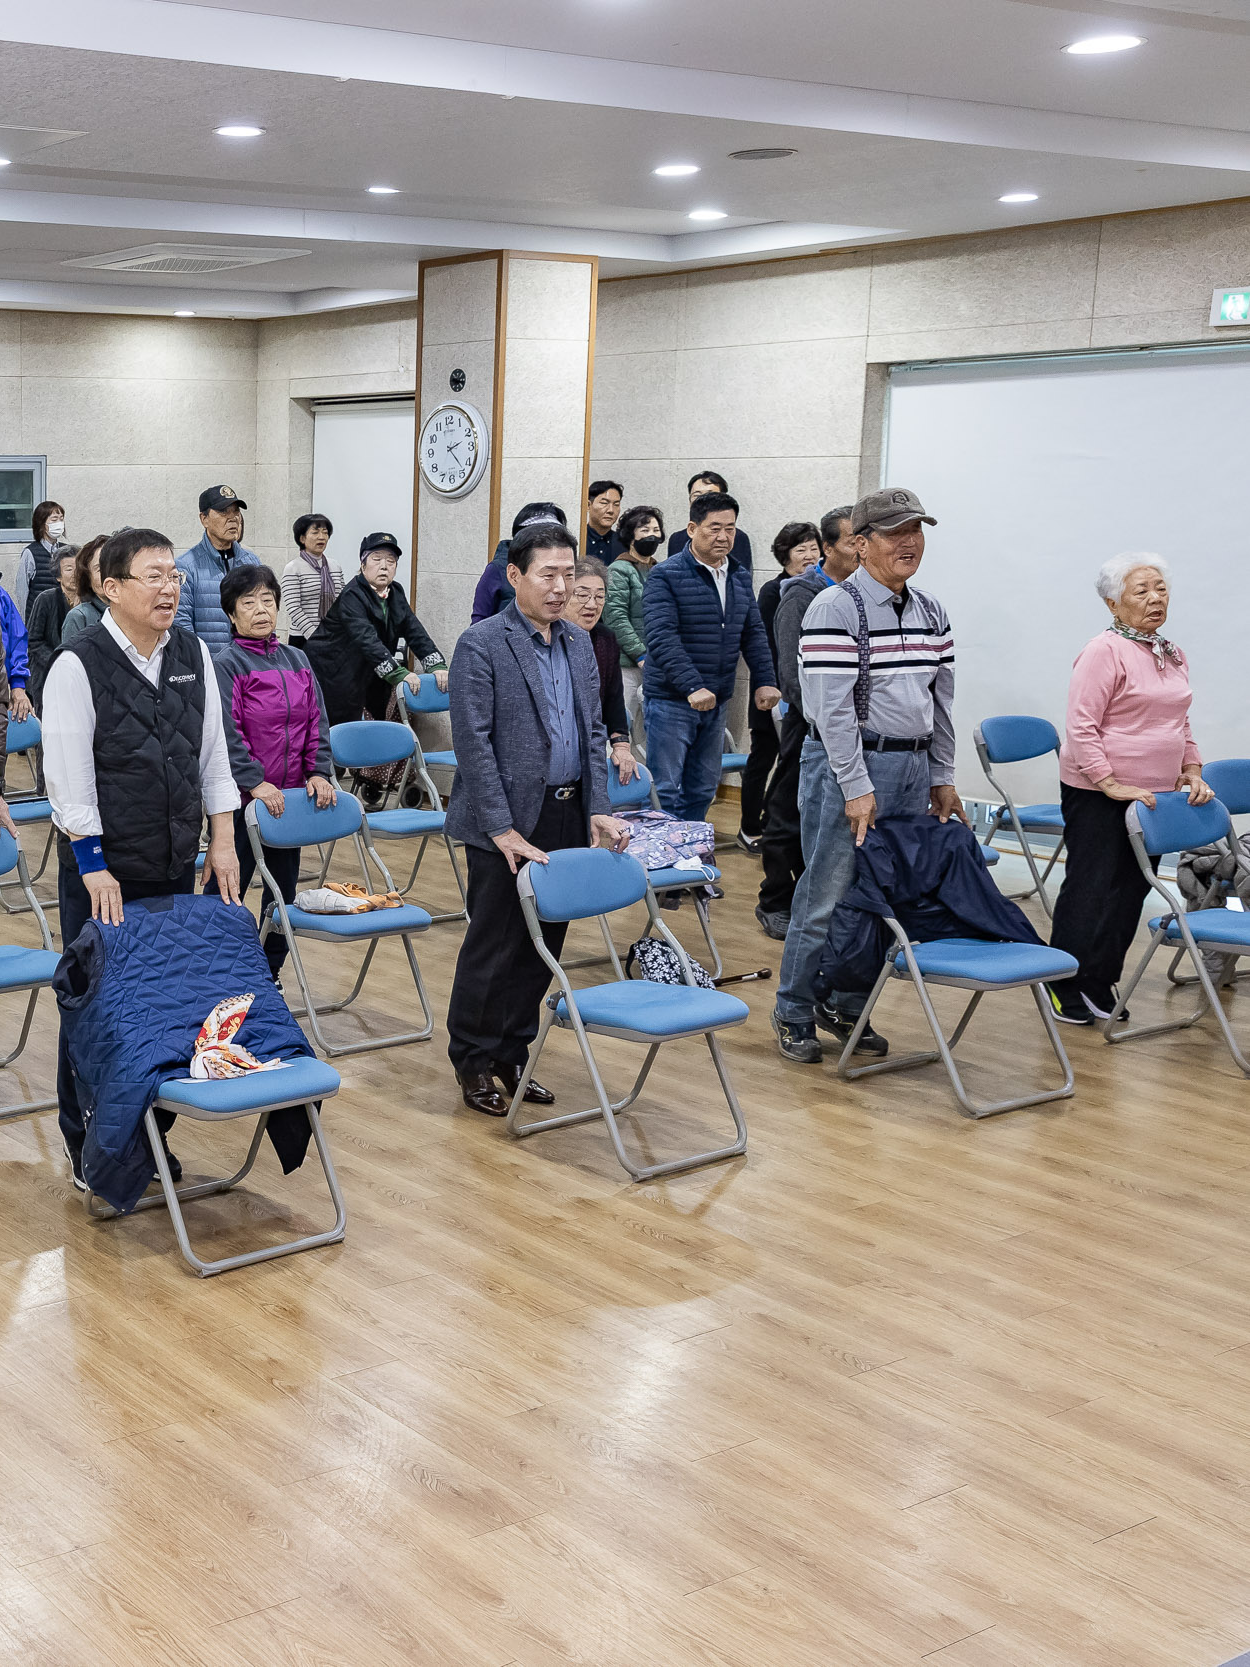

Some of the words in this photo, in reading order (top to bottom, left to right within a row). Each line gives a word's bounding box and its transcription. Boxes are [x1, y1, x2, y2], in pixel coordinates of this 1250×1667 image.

[445, 415, 454, 425] 12
[458, 418, 462, 428] 1
[435, 422, 442, 432] 11
[464, 428, 471, 437] 2
[429, 434, 437, 444] 10
[468, 441, 475, 451] 3
[428, 448, 434, 458] 9
[465, 457, 472, 467] 4
[431, 463, 438, 473] 8
[439, 473, 446, 483] 7
[458, 468, 465, 479] 5
[449, 474, 455, 484] 6
